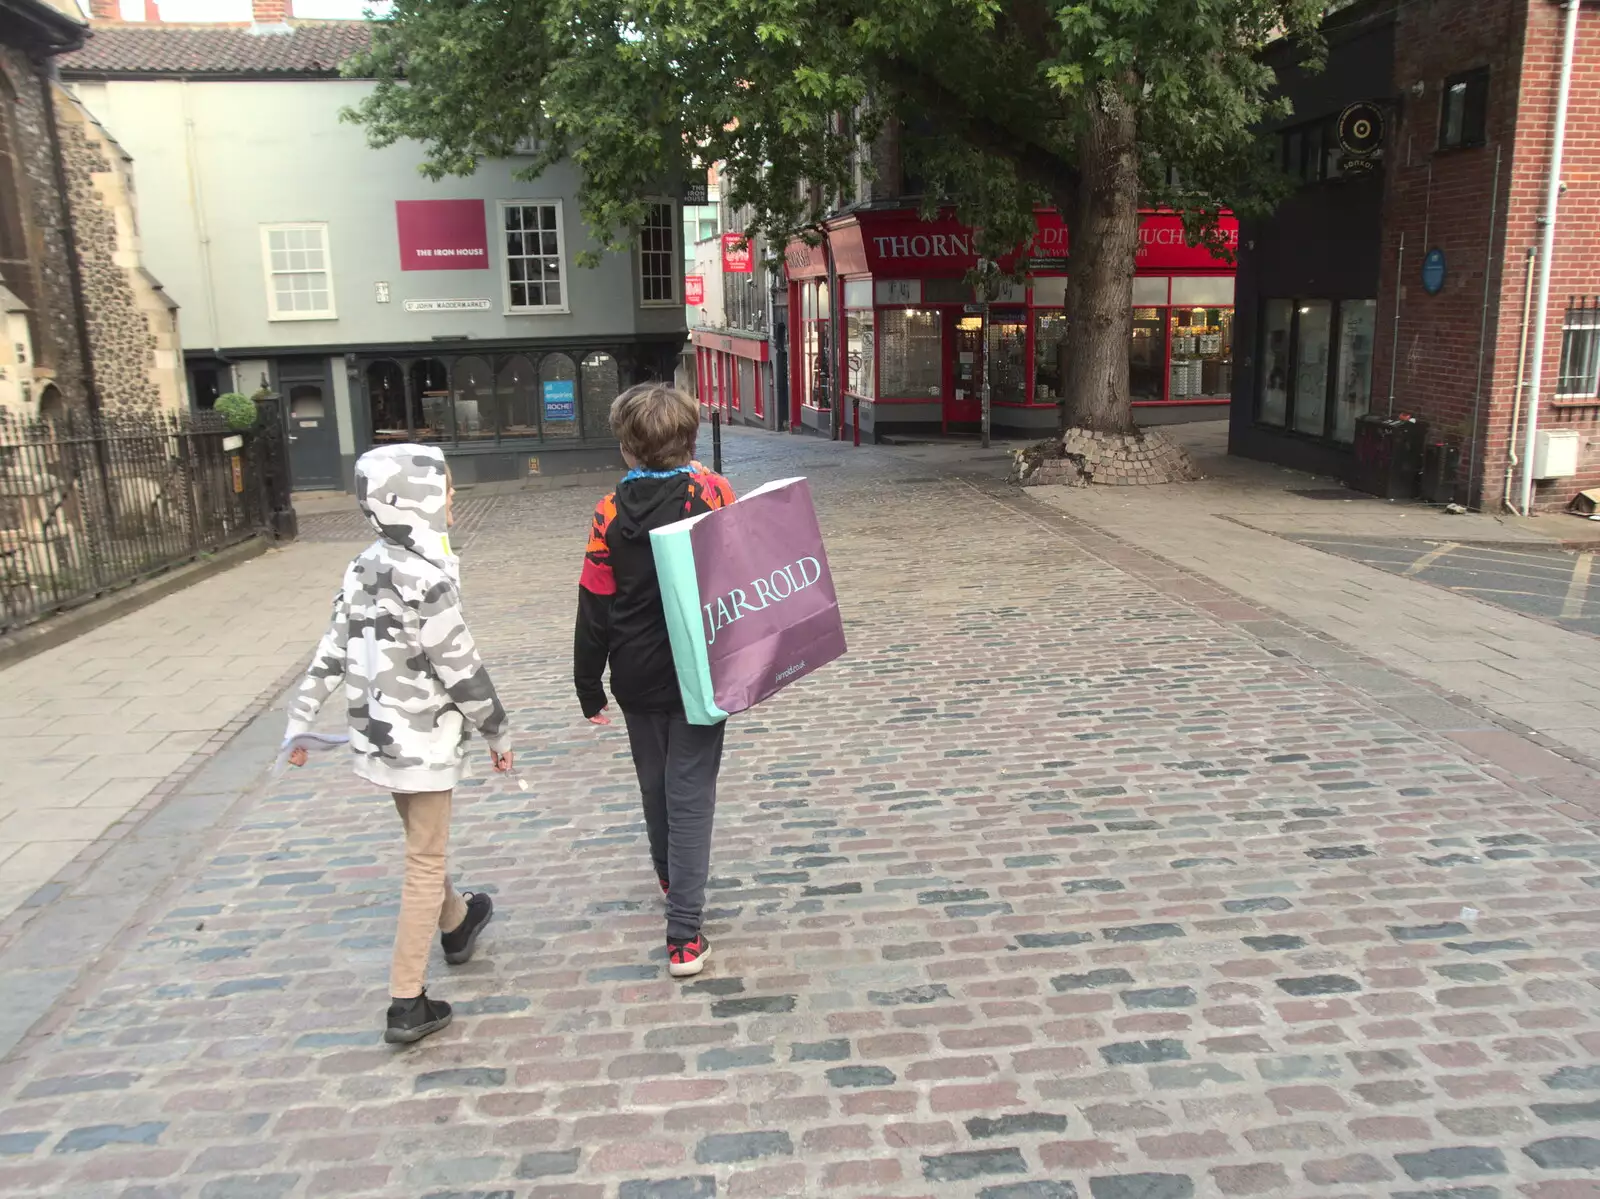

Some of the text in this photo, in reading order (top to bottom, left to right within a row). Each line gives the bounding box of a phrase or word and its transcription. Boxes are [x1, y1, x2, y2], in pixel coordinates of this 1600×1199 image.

[416, 249, 432, 257] THE
[456, 248, 484, 256] HOUSE
[437, 301, 487, 309] MADDERMARKET
[704, 556, 821, 645] JARROLD
[775, 659, 806, 684] jarrold.co.uk
